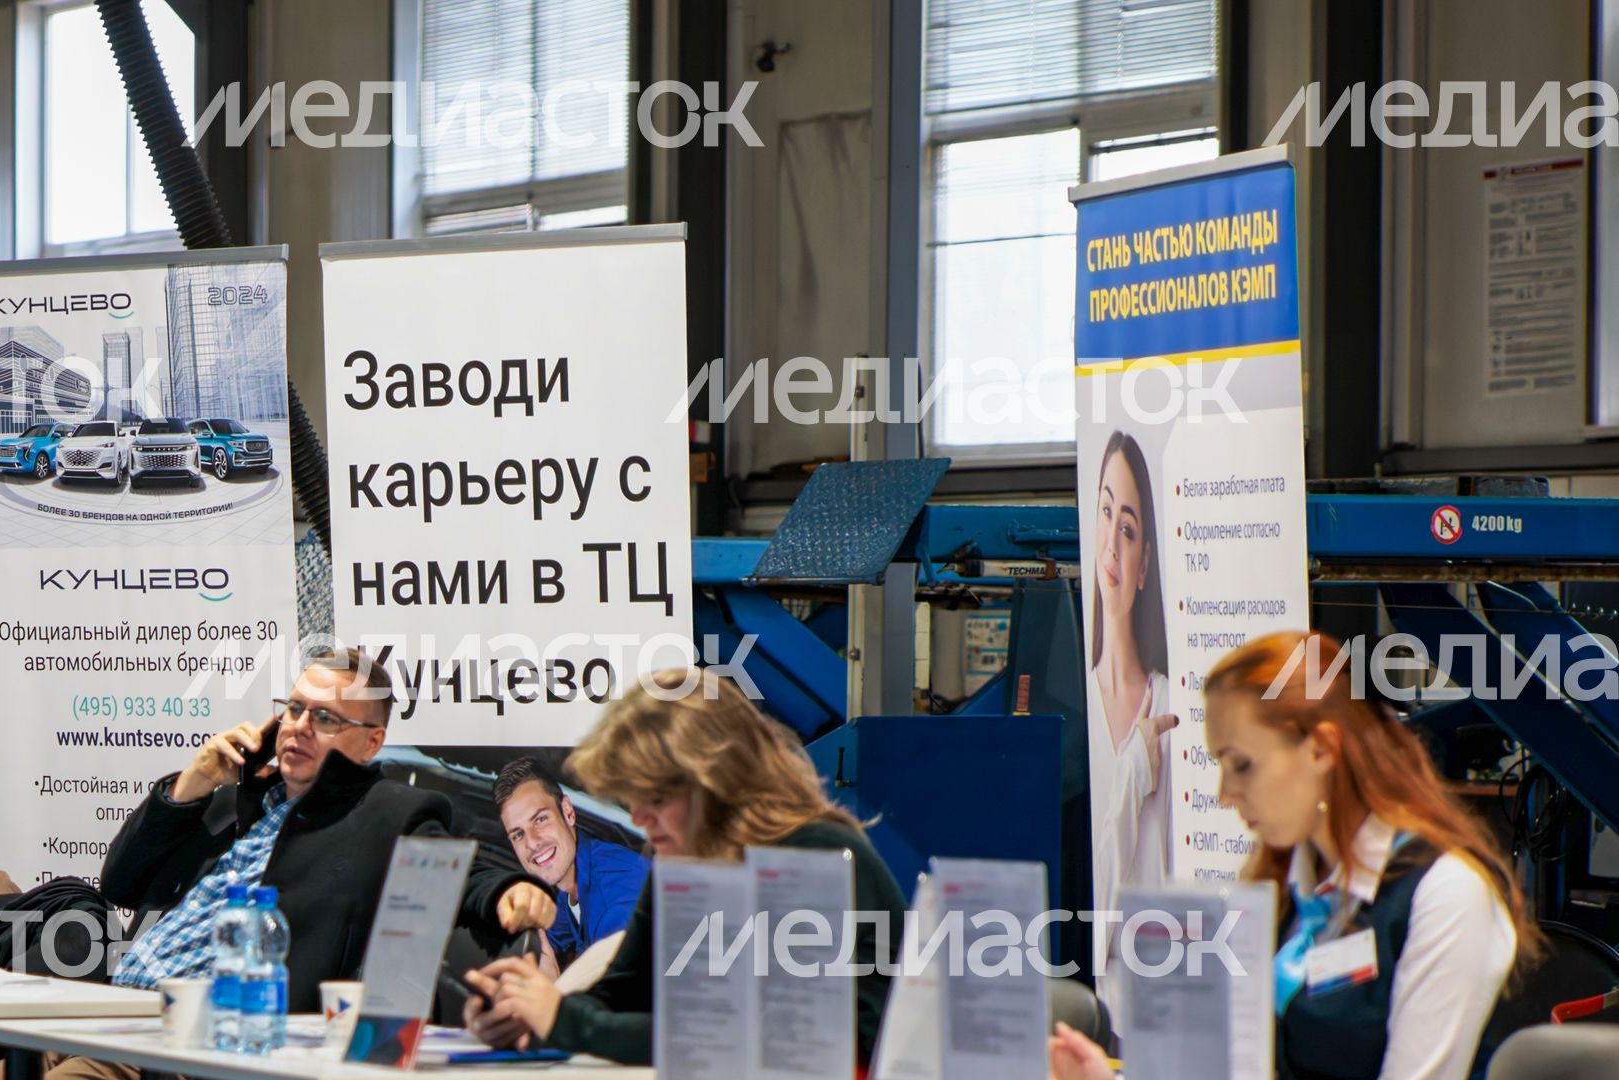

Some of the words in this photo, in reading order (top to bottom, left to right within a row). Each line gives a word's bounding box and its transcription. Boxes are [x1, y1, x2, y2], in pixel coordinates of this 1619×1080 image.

[1087, 235, 1131, 272] СТАНЬ
[1133, 224, 1193, 265] ЧАСТЬЮ
[1195, 209, 1278, 255] КОМАНДЫ
[207, 285, 268, 306] 2024
[1089, 271, 1228, 322] ПРОФЕССИОНАЛОВ
[1231, 264, 1276, 304] КЭМП
[343, 350, 570, 418] Заводи
[348, 456, 599, 523] карьеру
[619, 455, 652, 502] с
[1183, 478, 1208, 498] Белая
[1209, 475, 1259, 500] заработная
[1260, 476, 1285, 494] плата
[37, 503, 66, 517] БОЛЕЕ
[68, 509, 81, 518] 30
[82, 511, 124, 521] БРЕНДОВ
[126, 513, 139, 521] НА
[140, 510, 171, 521] ОДНОЙ
[172, 502, 234, 519] ТЕРРИТОРИИ!
[1184, 521, 1242, 546] Оформление
[1243, 521, 1281, 539] согласно
[1471, 515, 1505, 532] 4200
[1506, 516, 1523, 533] kg
[1008, 566, 1062, 576] TECHMAX
[1185, 553, 1197, 573] ТК
[1198, 554, 1210, 573] РФ
[40, 569, 230, 593] КУНЦЕВО
[352, 559, 508, 606] нами
[532, 558, 566, 603] в
[582, 542, 674, 617] ТЦ
[1186, 597, 1246, 622] Компенсация
[1247, 600, 1286, 621] расходов
[136, 625, 192, 644] дилер
[197, 620, 251, 641] более
[257, 620, 278, 640] 30
[1187, 633, 1198, 648] на
[1200, 632, 1246, 652] транспорт
[24, 651, 171, 672] автомобильных
[177, 651, 255, 676] брендов
[72, 695, 118, 721] (495)
[124, 697, 156, 717] 933
[162, 697, 183, 717] 40
[189, 697, 211, 717] 33
[56, 727, 218, 748] www.kuntsevo.co
[134, 780, 143, 793] и
[96, 806, 134, 821] опла
[48, 837, 110, 859] Корпор
[1193, 831, 1219, 852] КЭМП
